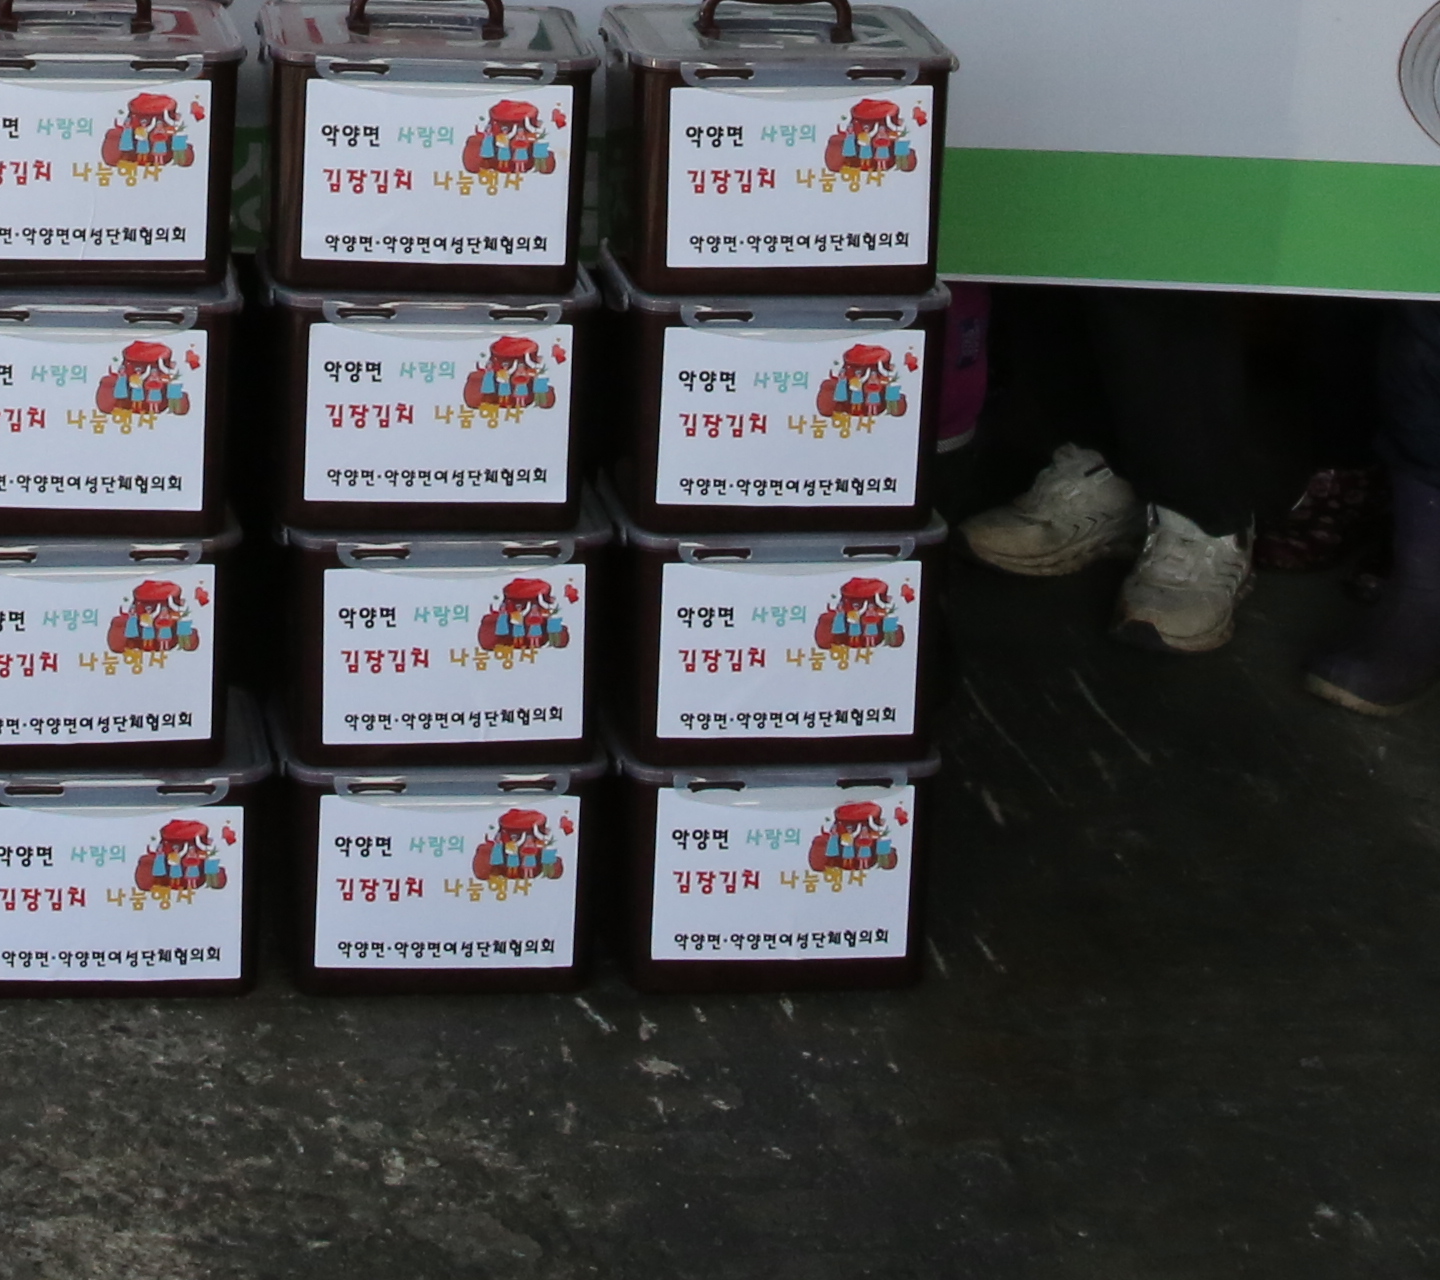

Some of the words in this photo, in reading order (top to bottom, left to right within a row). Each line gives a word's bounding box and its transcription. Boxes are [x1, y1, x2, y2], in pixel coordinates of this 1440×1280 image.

[35, 115, 96, 138] 사랑의
[685, 125, 744, 149] 악양면
[759, 121, 819, 146] 사랑의
[70, 158, 164, 186] 나눔행사
[687, 166, 776, 195] 김장김치
[794, 163, 886, 193] 나눔행사
[323, 360, 383, 384] 악양면
[398, 358, 458, 382] 사랑의
[325, 402, 414, 429] 김장김치
[432, 400, 525, 428] 나눔행사
[41, 604, 101, 630] 사랑의
[676, 606, 735, 629] 악양면
[751, 601, 810, 627] 사랑의
[76, 644, 169, 676] 나눔행사
[678, 646, 766, 674] 김장김치
[784, 640, 875, 671] 나눔행사
[334, 836, 393, 858] 악양면
[408, 831, 468, 856] 사랑의
[335, 876, 424, 903] 김장김치
[442, 872, 533, 901] 나눔행사
